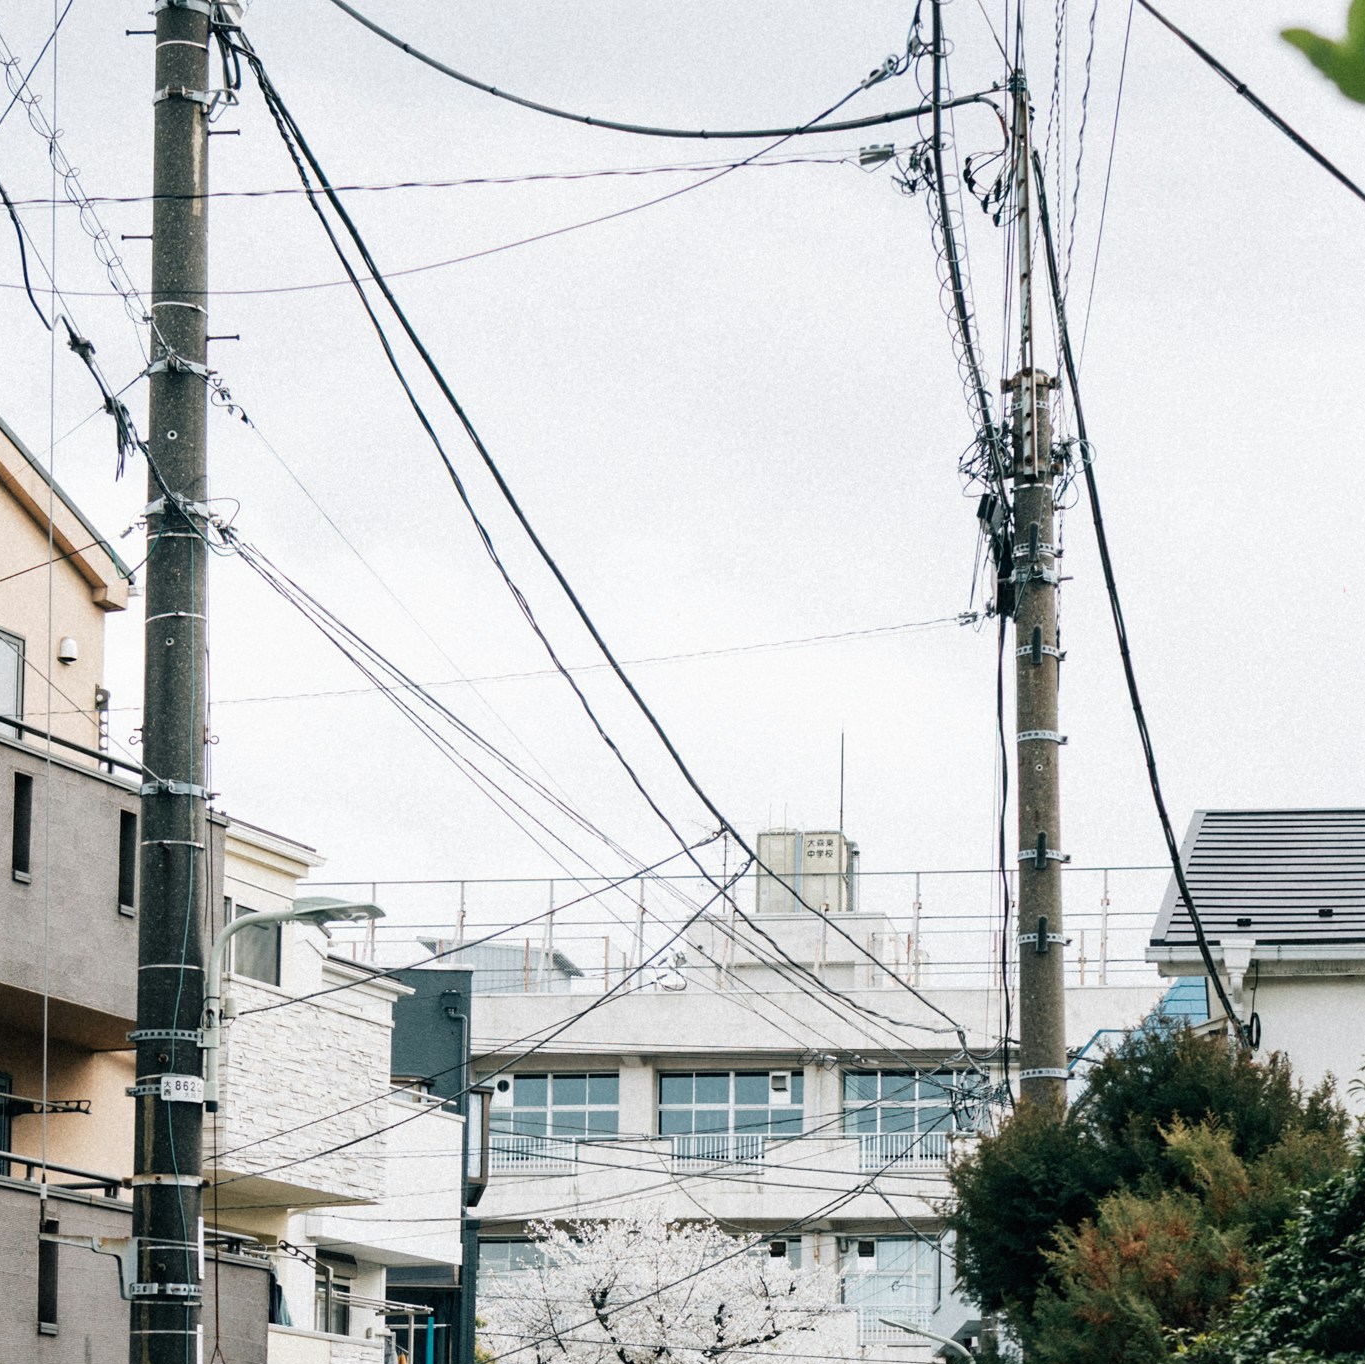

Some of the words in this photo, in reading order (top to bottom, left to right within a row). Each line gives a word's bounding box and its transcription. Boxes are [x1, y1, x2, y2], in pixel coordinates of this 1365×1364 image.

[807, 839, 834, 847] 大森東
[807, 850, 834, 858] 中学校
